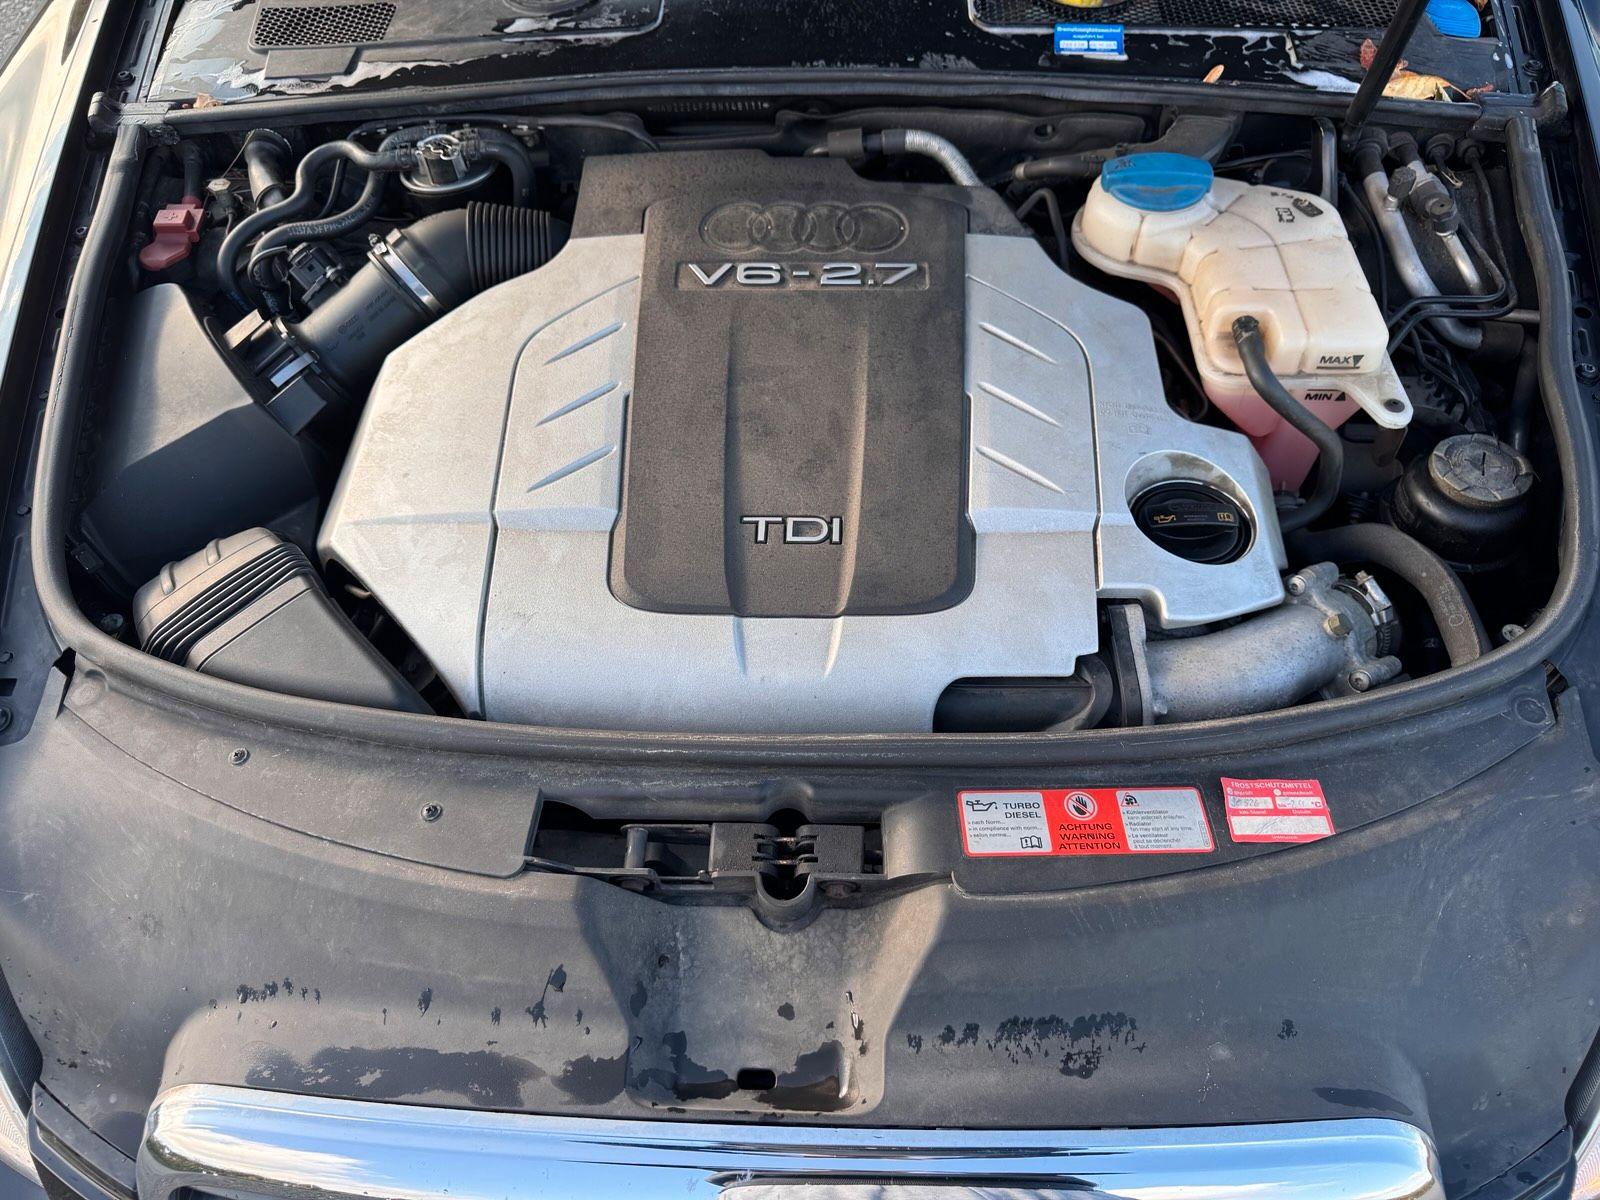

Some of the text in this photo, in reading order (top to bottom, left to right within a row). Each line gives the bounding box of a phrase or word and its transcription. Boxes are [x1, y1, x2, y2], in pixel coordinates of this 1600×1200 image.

[1319, 355, 1352, 365] MAX
[1304, 393, 1333, 401] MIN
[741, 515, 843, 544] TDI
[1231, 781, 1313, 789] FROSTSCHUTZMITTEL
[1002, 802, 1041, 810] TURBO
[1005, 811, 1042, 819] DIESEL
[1059, 822, 1113, 831] ACHTUNG
[1060, 832, 1116, 841] WARNING
[1059, 842, 1121, 850] ATTENTION
